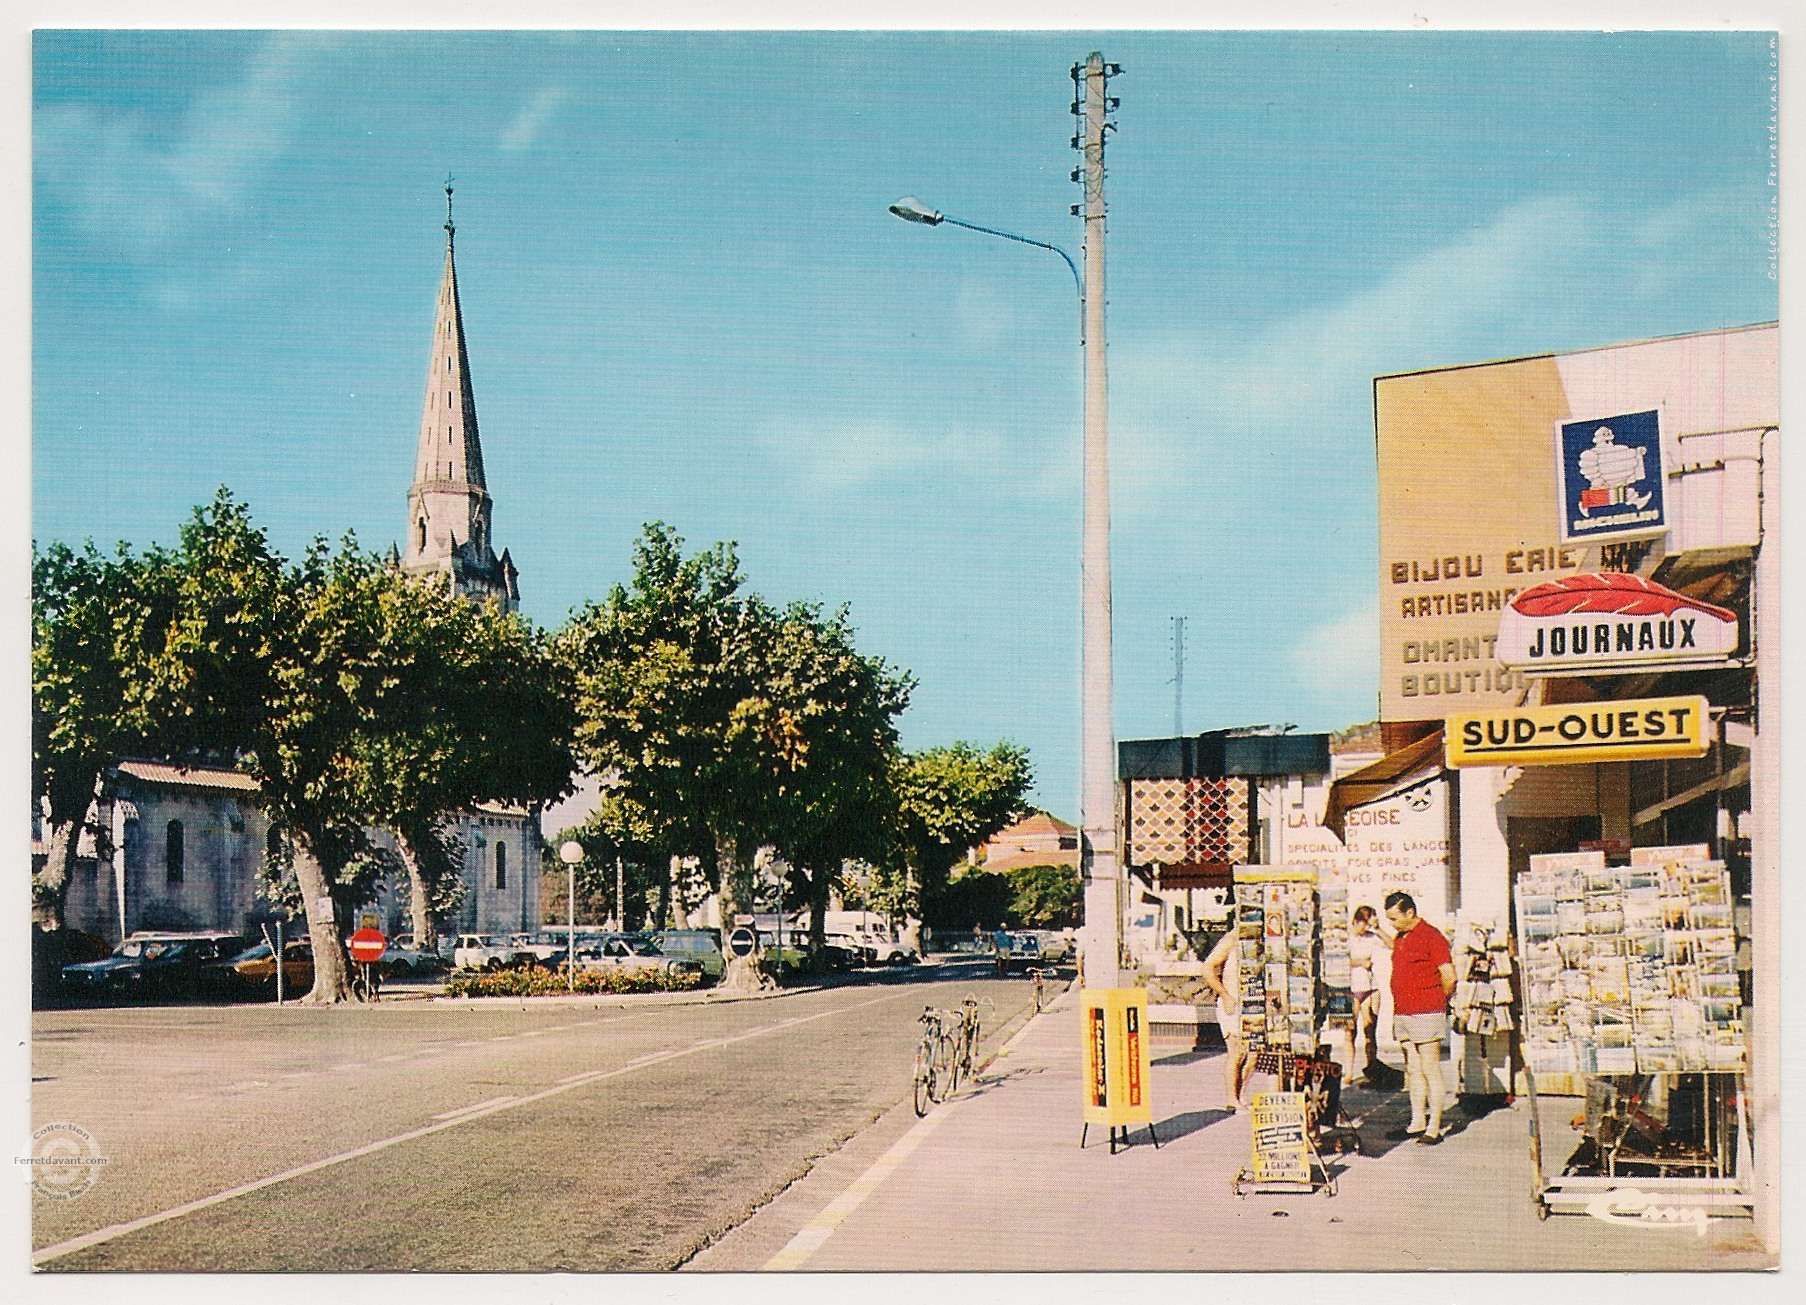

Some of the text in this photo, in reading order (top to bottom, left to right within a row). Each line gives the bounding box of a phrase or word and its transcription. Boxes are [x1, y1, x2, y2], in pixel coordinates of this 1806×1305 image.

[1391, 547, 1577, 584] BIJOU ERIE
[1529, 618, 1697, 659] JOURNAUX
[1463, 708, 1691, 746] SUD-OUEST
[1287, 812, 1308, 829] LA
